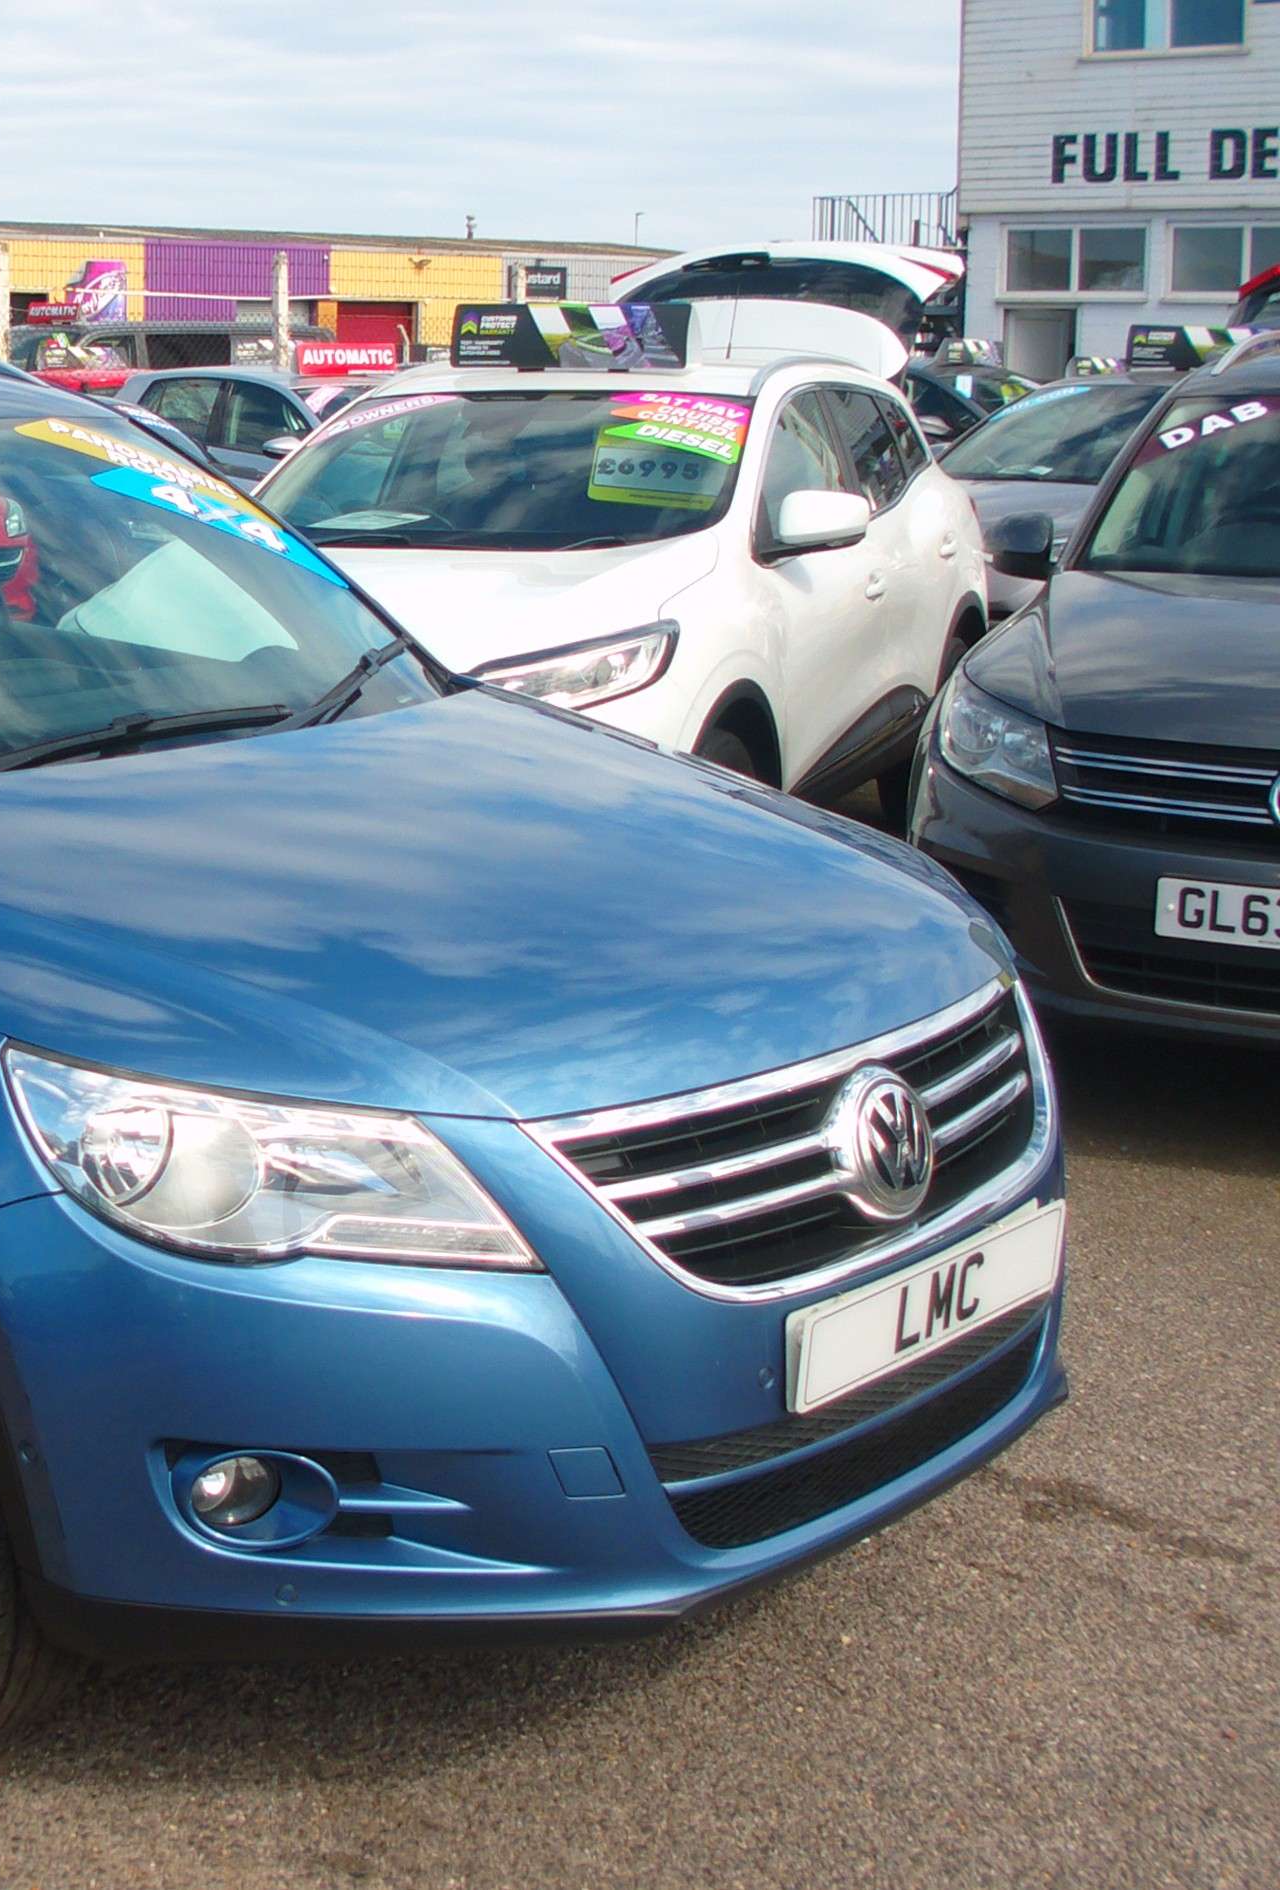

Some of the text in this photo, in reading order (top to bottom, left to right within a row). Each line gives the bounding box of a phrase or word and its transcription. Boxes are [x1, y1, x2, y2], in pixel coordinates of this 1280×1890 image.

[1051, 126, 1280, 184] FULL DE
[526, 272, 561, 285] ustard
[30, 305, 77, 317] AUTOMATIC
[303, 349, 394, 366] AUTOMATIC
[349, 396, 437, 424] OWNERS
[639, 393, 745, 418] SAT NAV
[657, 405, 738, 429] CRUISE
[637, 410, 737, 441] CONTROL
[1158, 401, 1269, 449] DAB
[635, 424, 733, 459] DIESEL
[47, 419, 239, 500] PANORAMIC
[597, 457, 699, 481] £6995
[894, 1250, 985, 1354] LMC
